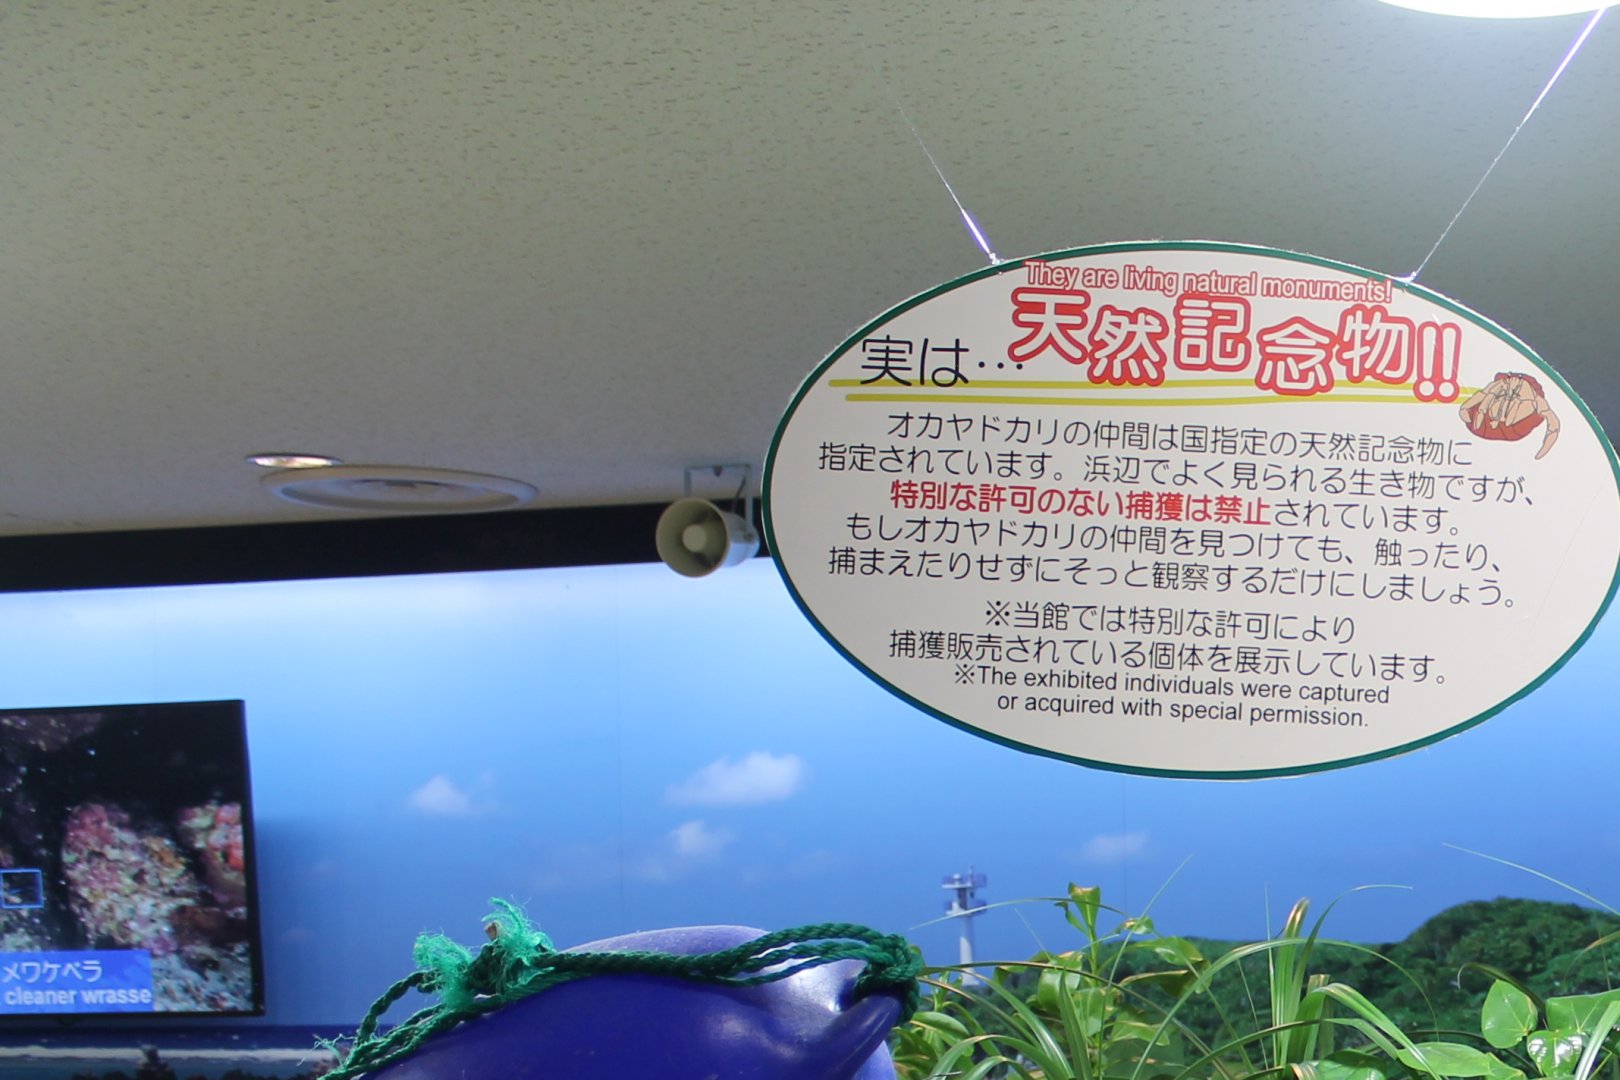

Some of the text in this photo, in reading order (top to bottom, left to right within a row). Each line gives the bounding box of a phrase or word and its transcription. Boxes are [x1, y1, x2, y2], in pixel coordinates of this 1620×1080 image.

[1025, 260, 1392, 303] They are living natural monuments!
[888, 411, 1473, 467] オカヤドカリの仲間は国指定の天然記念物に
[888, 629, 1446, 685] 捕獲販売されている個体を展示しています。
[1023, 669, 1117, 691] exhibited
[1124, 672, 1234, 697] individuals
[1241, 683, 1292, 699] were
[1299, 684, 1390, 705] captured
[997, 695, 1369, 728] or acquired with special permission.
[5, 987, 152, 1005] cleaner wrasse
